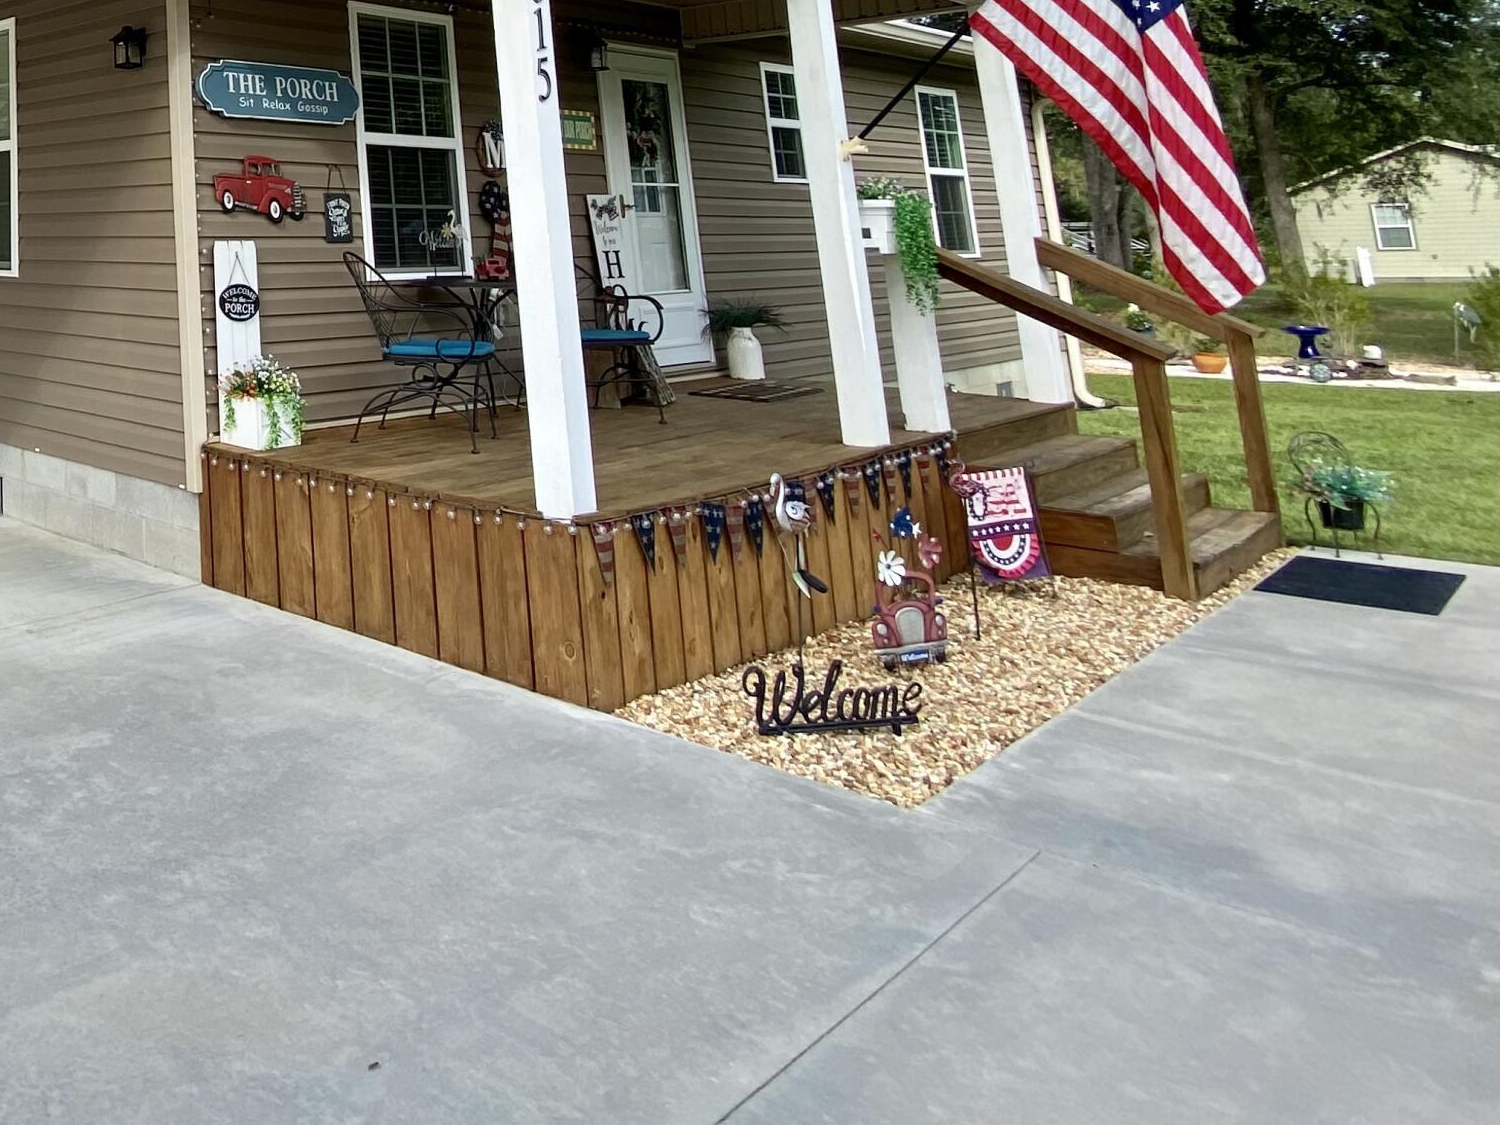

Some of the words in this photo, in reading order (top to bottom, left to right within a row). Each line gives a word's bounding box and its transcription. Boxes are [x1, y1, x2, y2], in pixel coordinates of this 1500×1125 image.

[223, 71, 267, 96] THE
[275, 76, 339, 102] PORCH
[238, 96, 254, 108] Sit
[262, 98, 291, 111] Relax
[297, 101, 329, 116] Gossip
[222, 287, 257, 301] WELCOME
[225, 303, 255, 314] PORCH
[742, 659, 923, 727] Welcome
